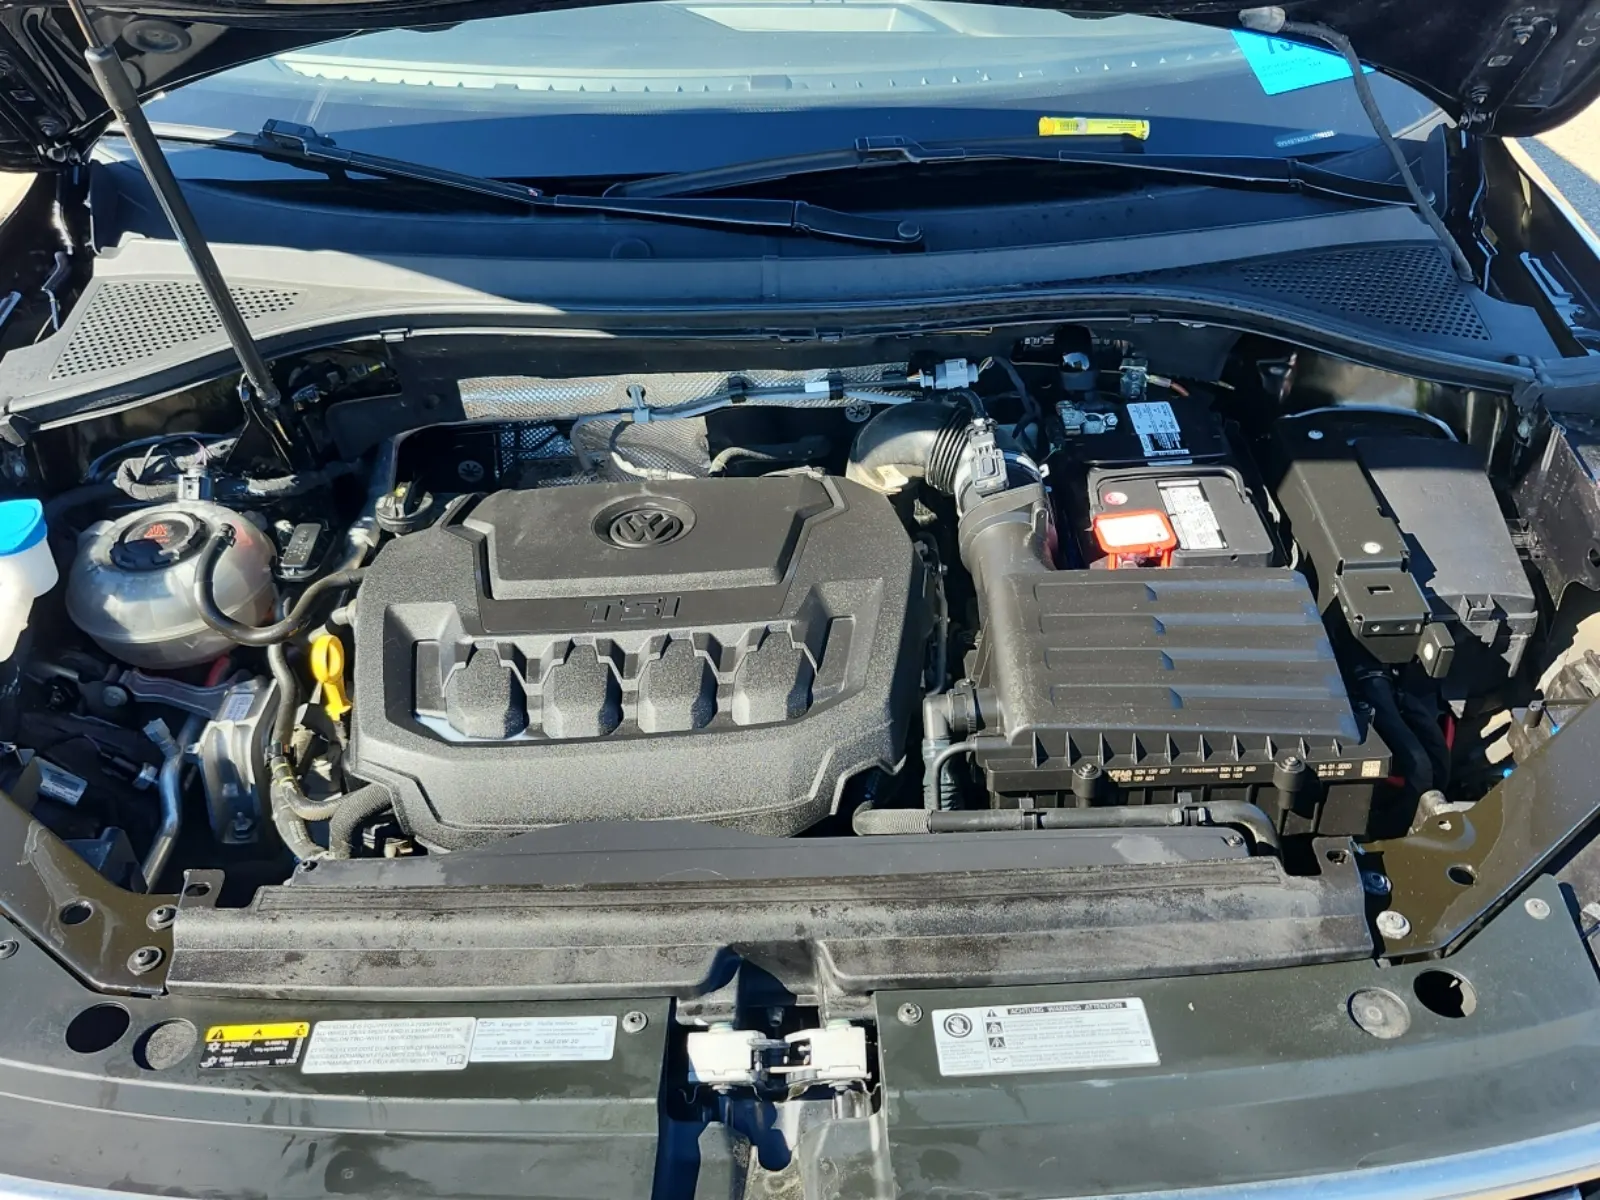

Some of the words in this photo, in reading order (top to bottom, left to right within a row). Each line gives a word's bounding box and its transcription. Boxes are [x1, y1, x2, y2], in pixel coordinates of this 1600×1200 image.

[585, 596, 681, 622] TSI
[1010, 1006, 1044, 1014] ACHTUNG
[1048, 1004, 1081, 1012] WARNING
[1084, 1002, 1122, 1010] ATTENTION
